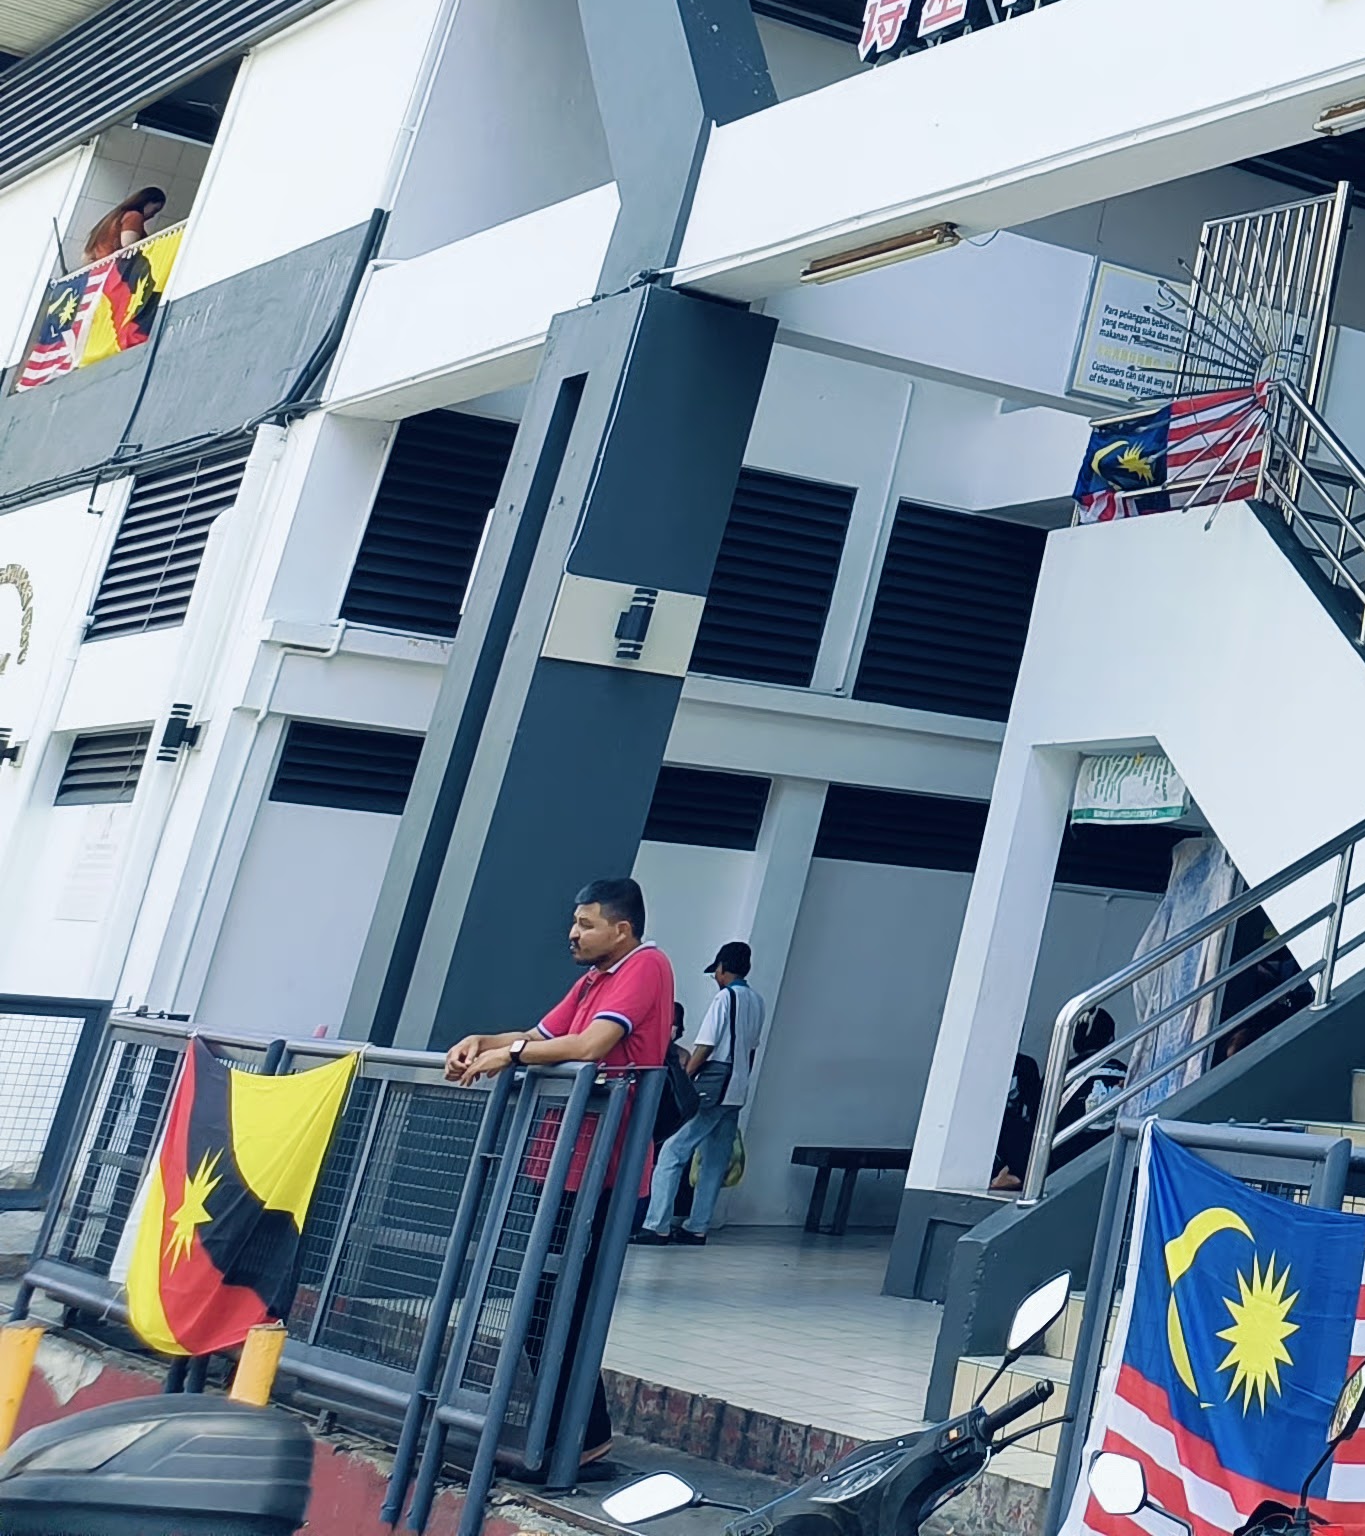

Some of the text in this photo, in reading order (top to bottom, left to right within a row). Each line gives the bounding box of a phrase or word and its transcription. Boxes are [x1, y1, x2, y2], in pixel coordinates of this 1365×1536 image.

[1104, 304, 1118, 316] Para
[1091, 361, 1125, 377] Customers
[1097, 375, 1108, 386] the
